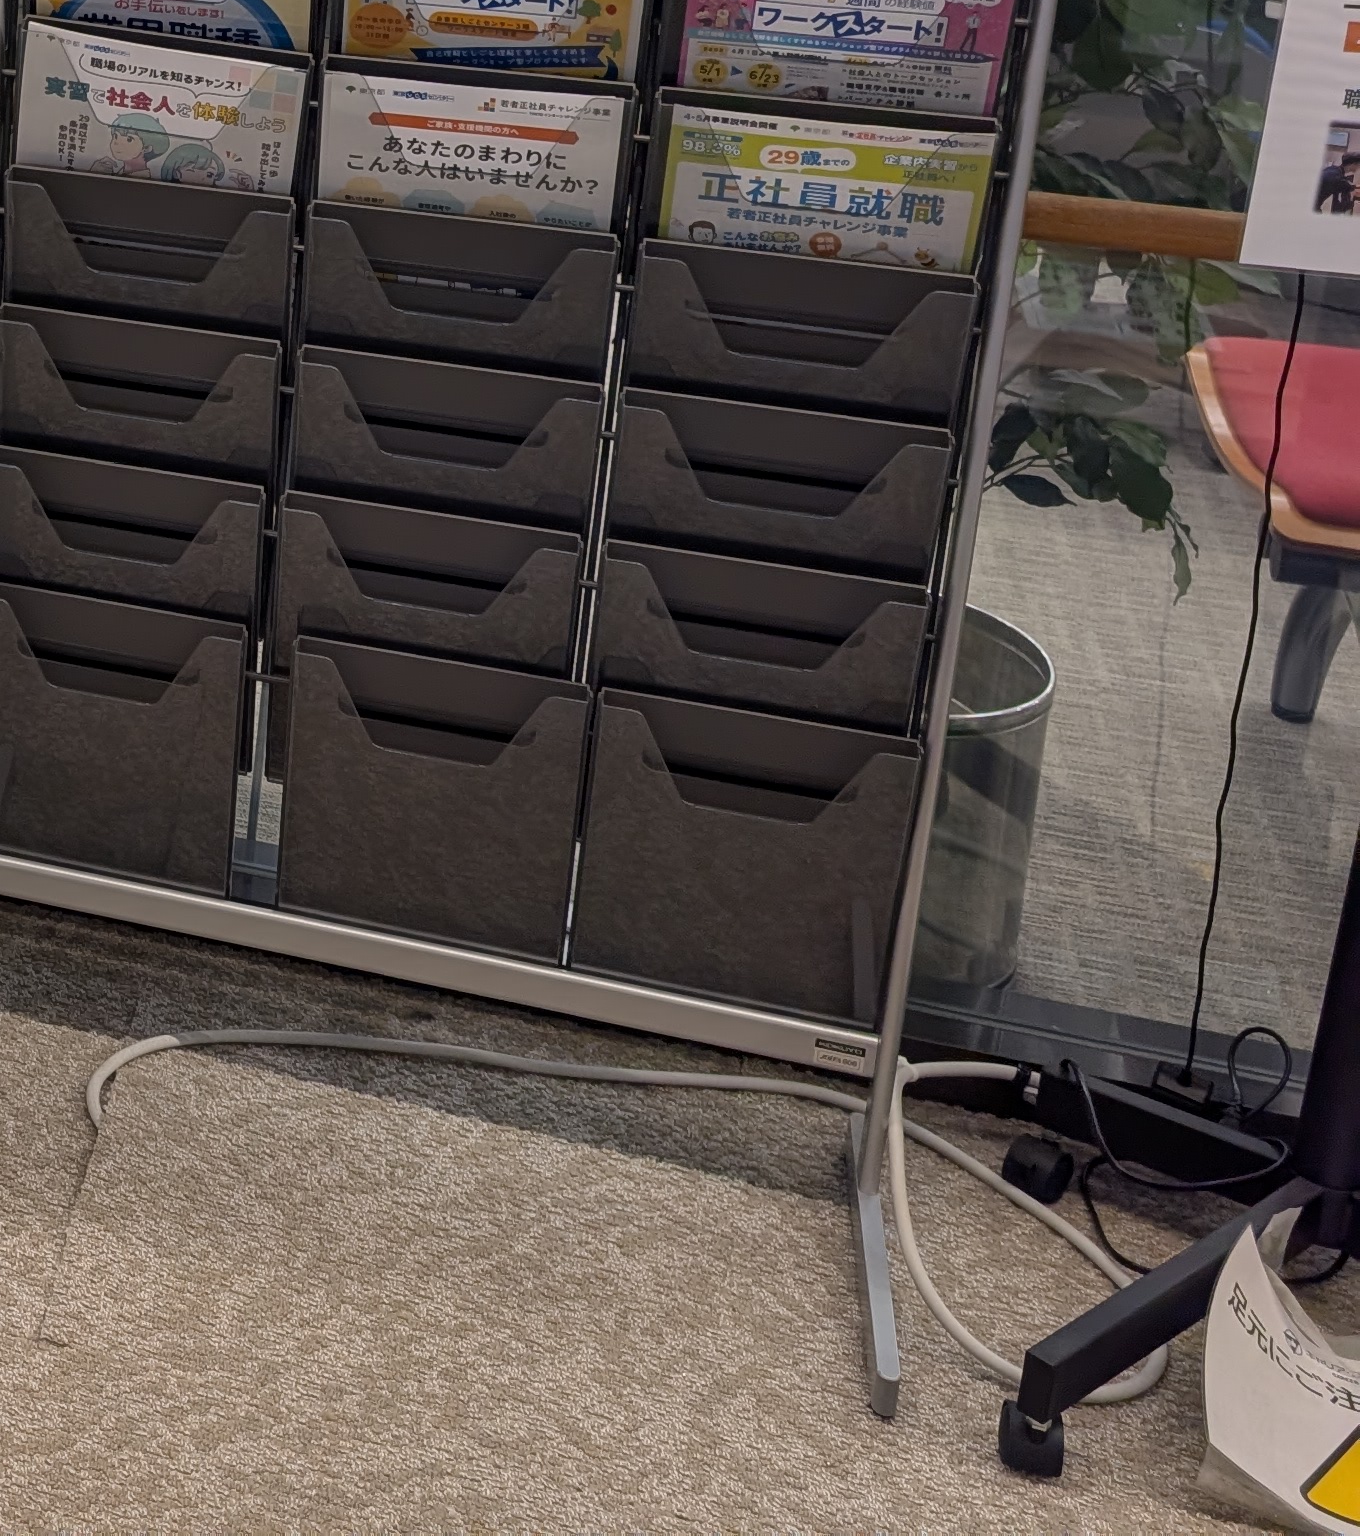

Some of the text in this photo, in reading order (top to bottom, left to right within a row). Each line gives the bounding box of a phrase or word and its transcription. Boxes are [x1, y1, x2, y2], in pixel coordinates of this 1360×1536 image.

[756, 6, 944, 44] ワークスタート!
[89, 56, 242, 92] 職場のリアルを知るチャンス!
[43, 76, 286, 134] 実習で社会人を体験しよう
[382, 135, 567, 172] あなたのまわりに
[346, 153, 599, 196] こんな人はいませんか?
[698, 170, 945, 227] 正社員就職
